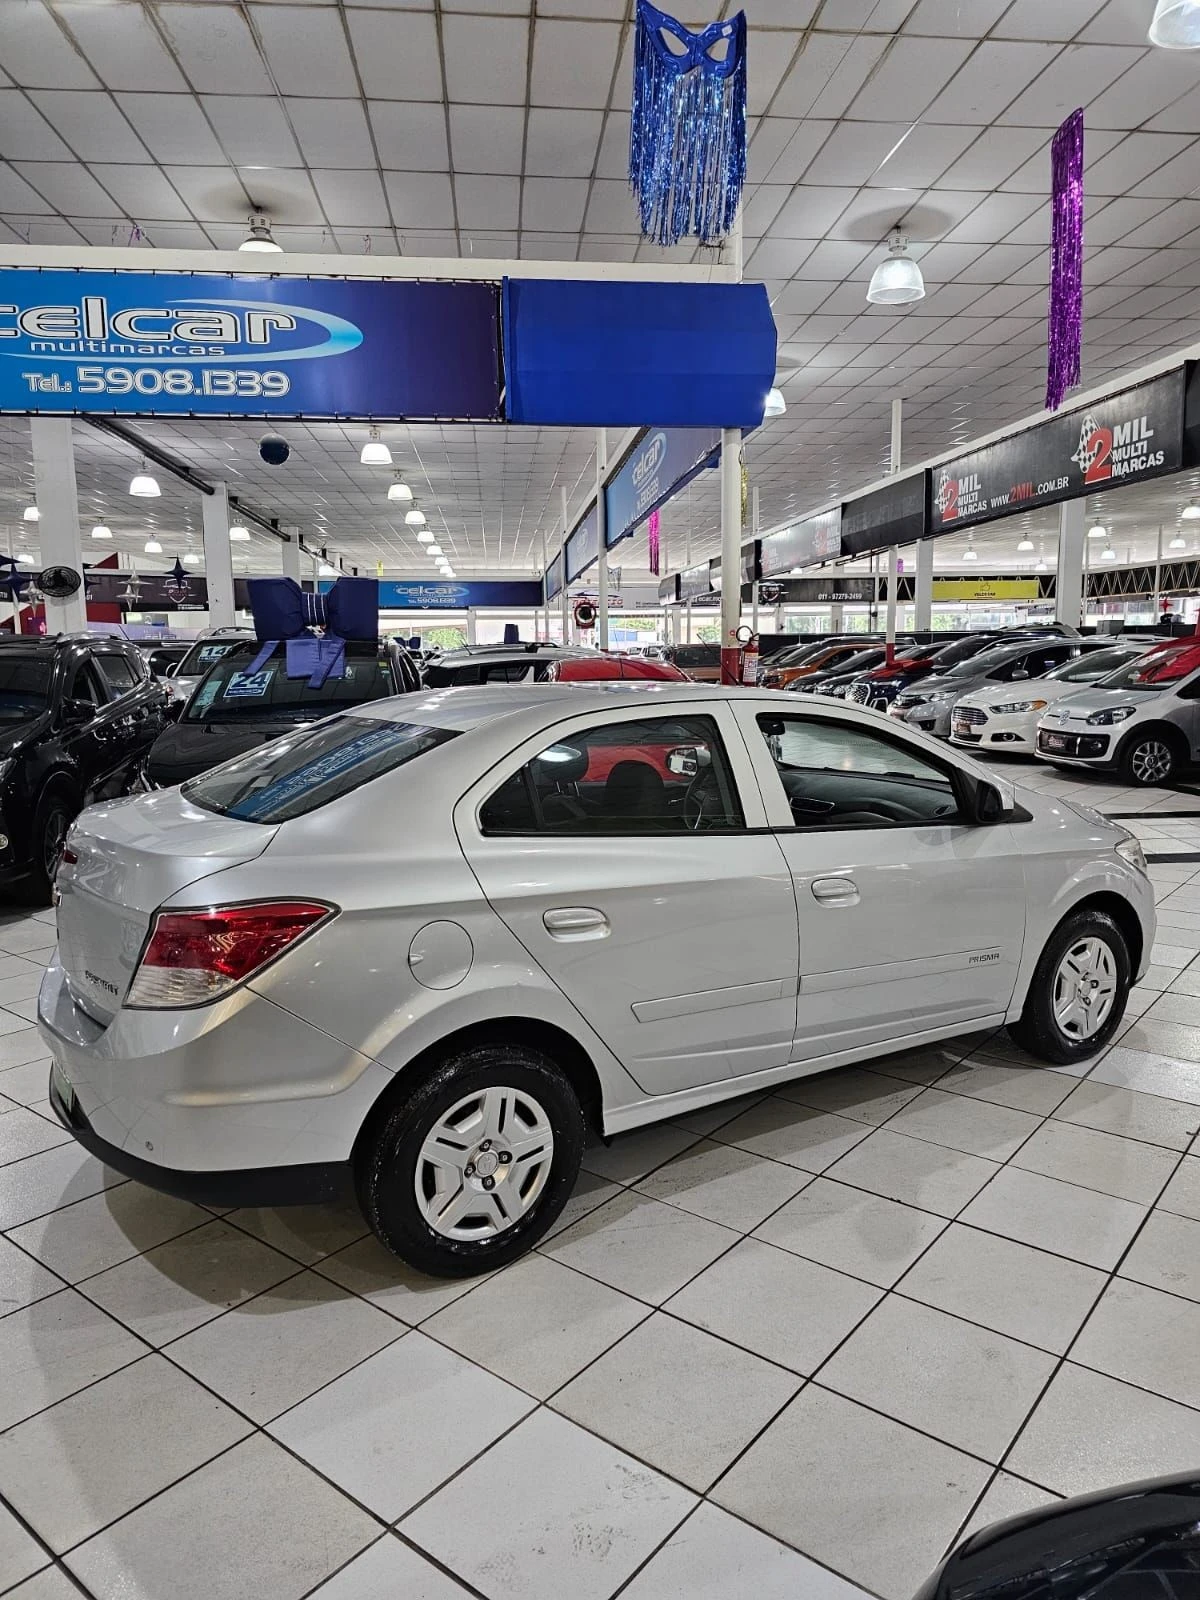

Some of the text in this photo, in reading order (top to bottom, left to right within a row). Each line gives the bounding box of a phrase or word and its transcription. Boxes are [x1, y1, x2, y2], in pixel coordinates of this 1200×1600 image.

[30, 340, 225, 357] multimarcas
[77, 365, 290, 398] 5908.1339
[1084, 416, 1154, 484] 2 MIL
[1112, 440, 1147, 463] MULTI
[1112, 451, 1165, 478] MARCAS
[958, 474, 982, 497] MIL
[957, 491, 979, 507] MULTI
[958, 500, 988, 517] MARCAS
[969, 953, 999, 964] PRISMA
